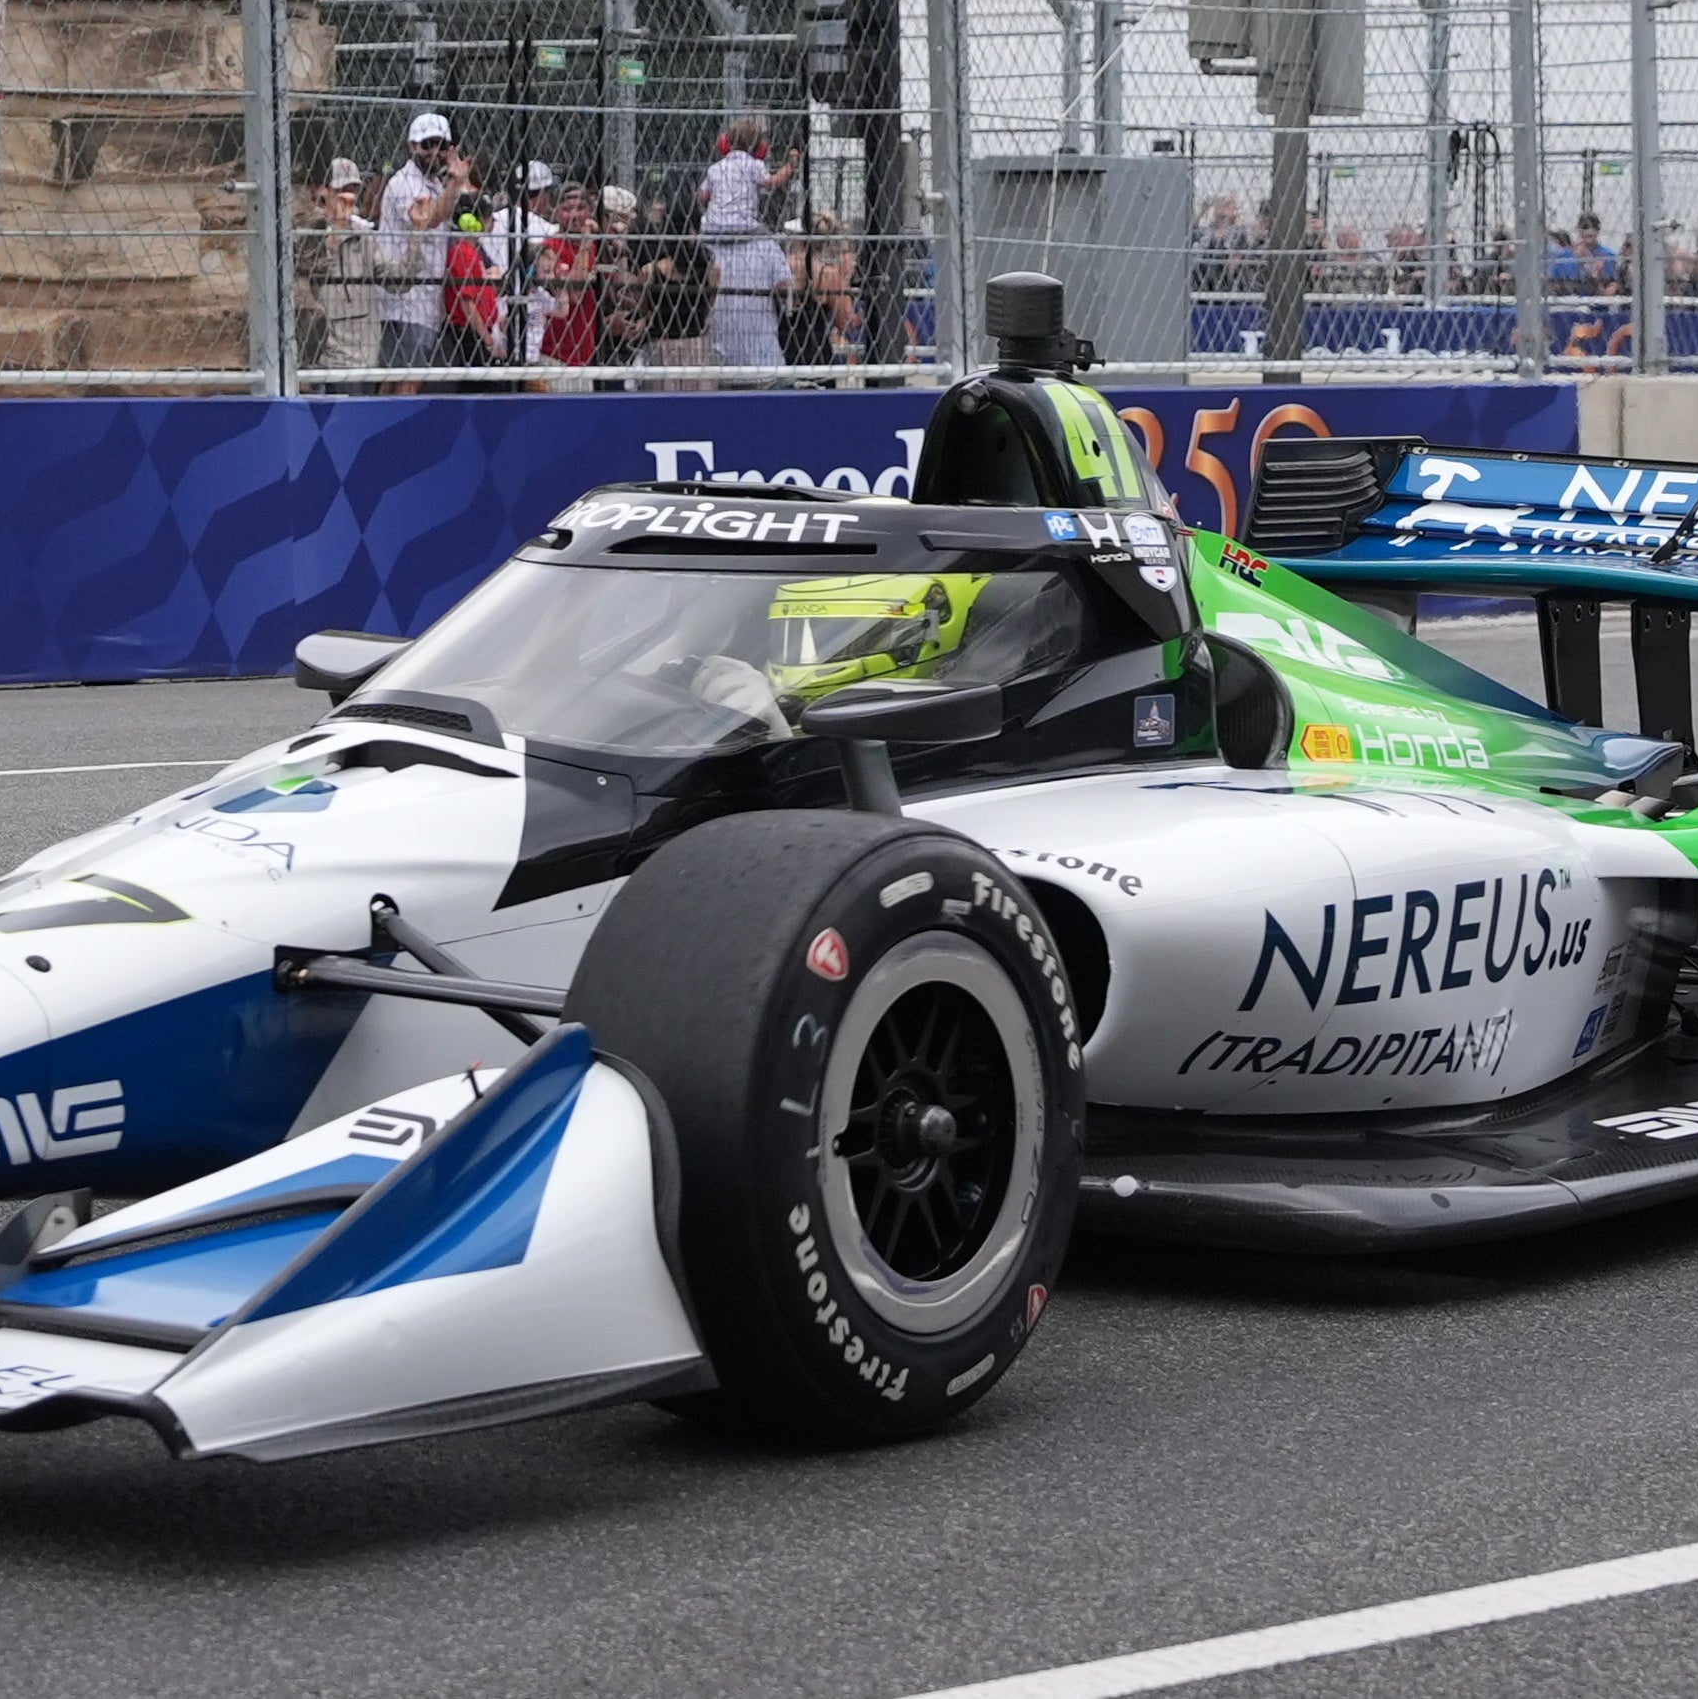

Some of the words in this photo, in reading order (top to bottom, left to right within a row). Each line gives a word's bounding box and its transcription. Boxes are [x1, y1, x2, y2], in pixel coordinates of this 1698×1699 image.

[1089, 552, 1132, 564] Honda
[1353, 723, 1491, 770] Honda
[970, 870, 1081, 1072] Firestone
[787, 1202, 910, 1402] Firestone
